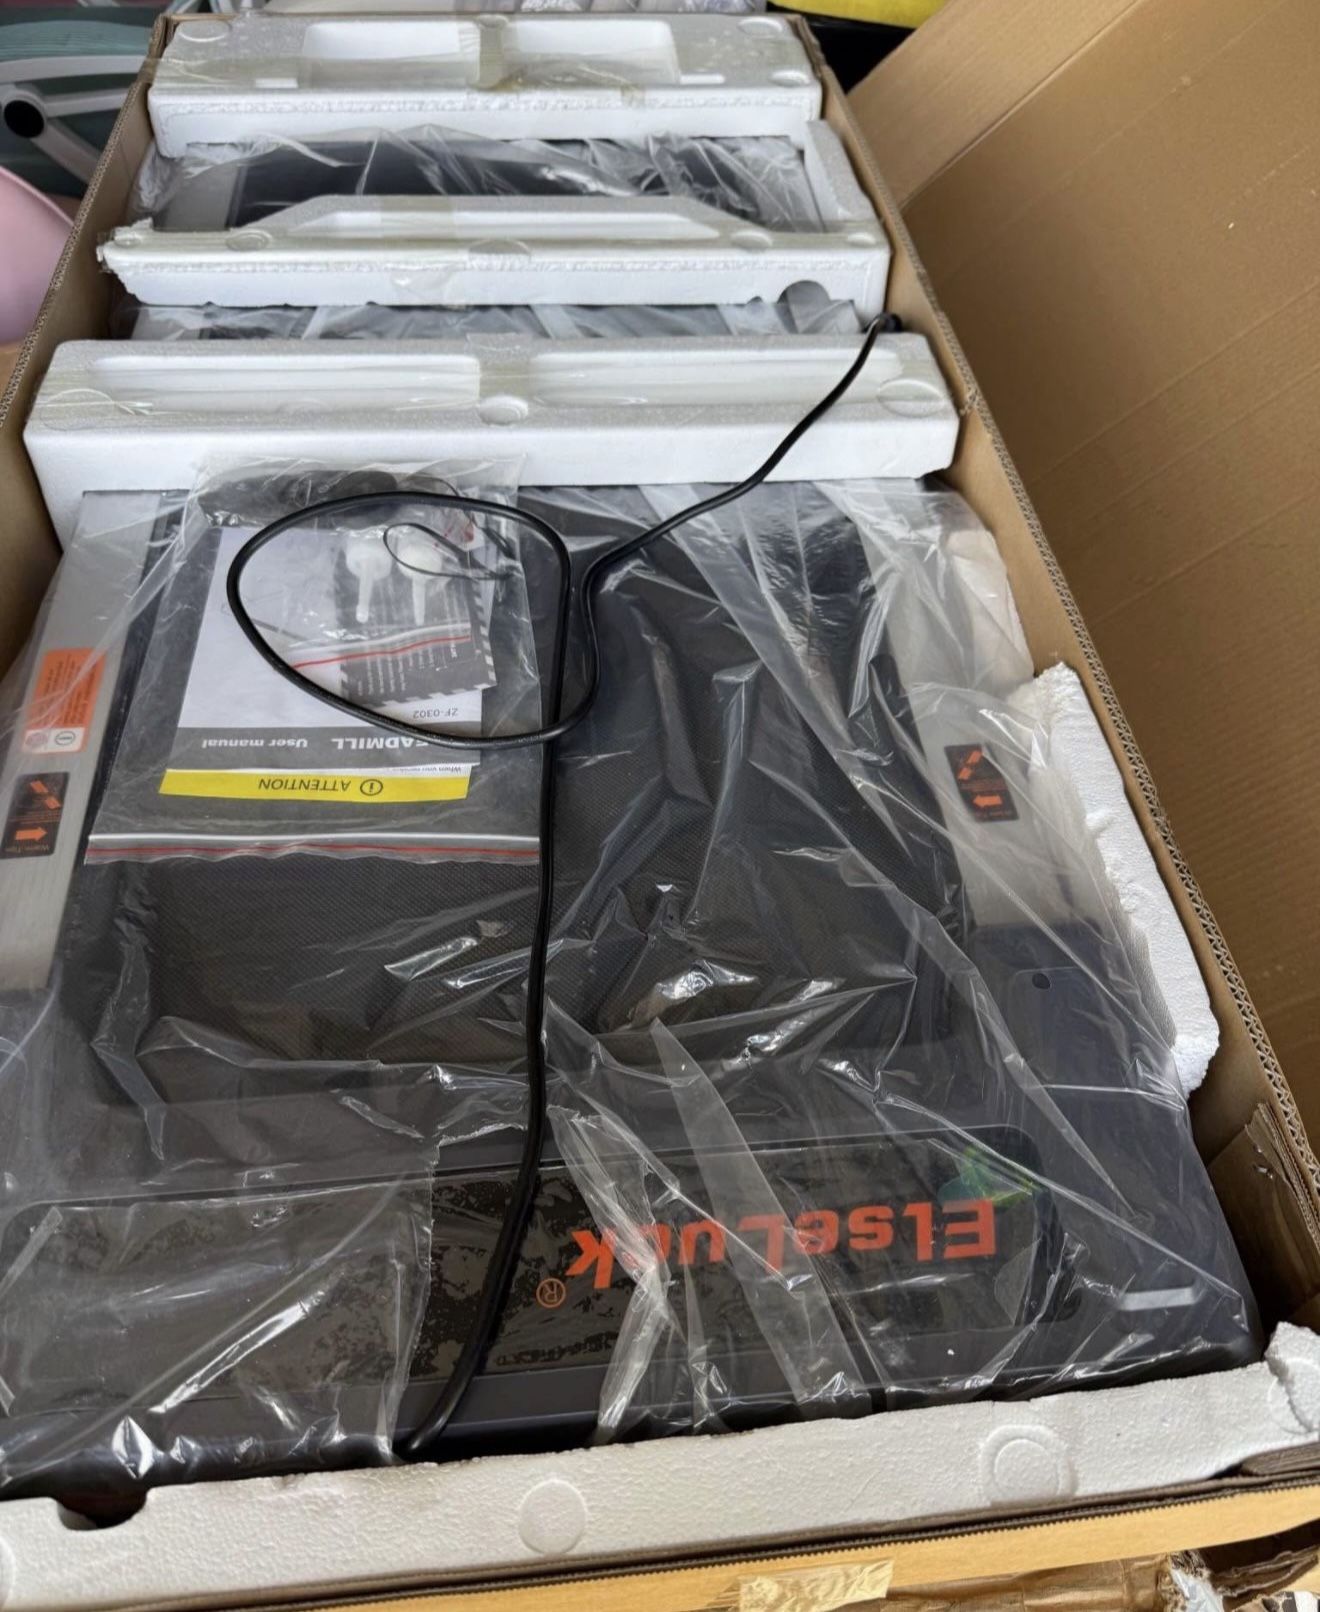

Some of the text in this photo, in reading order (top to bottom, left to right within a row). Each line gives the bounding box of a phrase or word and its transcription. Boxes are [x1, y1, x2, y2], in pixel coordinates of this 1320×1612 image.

[413, 707, 459, 718] ZF-0302
[202, 739, 265, 749] manual
[268, 739, 309, 749] User
[258, 778, 351, 792] ATTENTION
